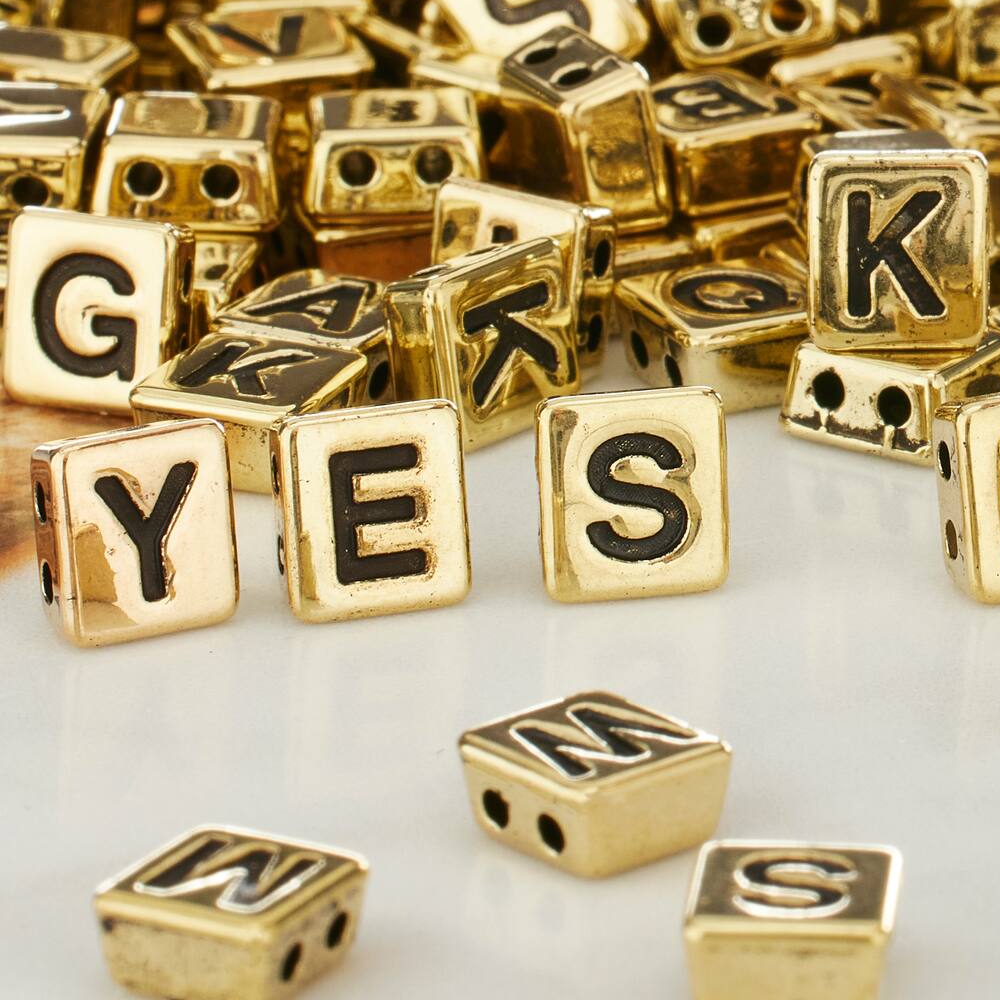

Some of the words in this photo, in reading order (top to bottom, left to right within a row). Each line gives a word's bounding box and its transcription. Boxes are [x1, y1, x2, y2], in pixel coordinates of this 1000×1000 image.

[31, 252, 138, 384] G
[845, 190, 949, 320] K
[462, 279, 561, 408] K
[93, 431, 690, 604] YES
[732, 850, 859, 918] S
